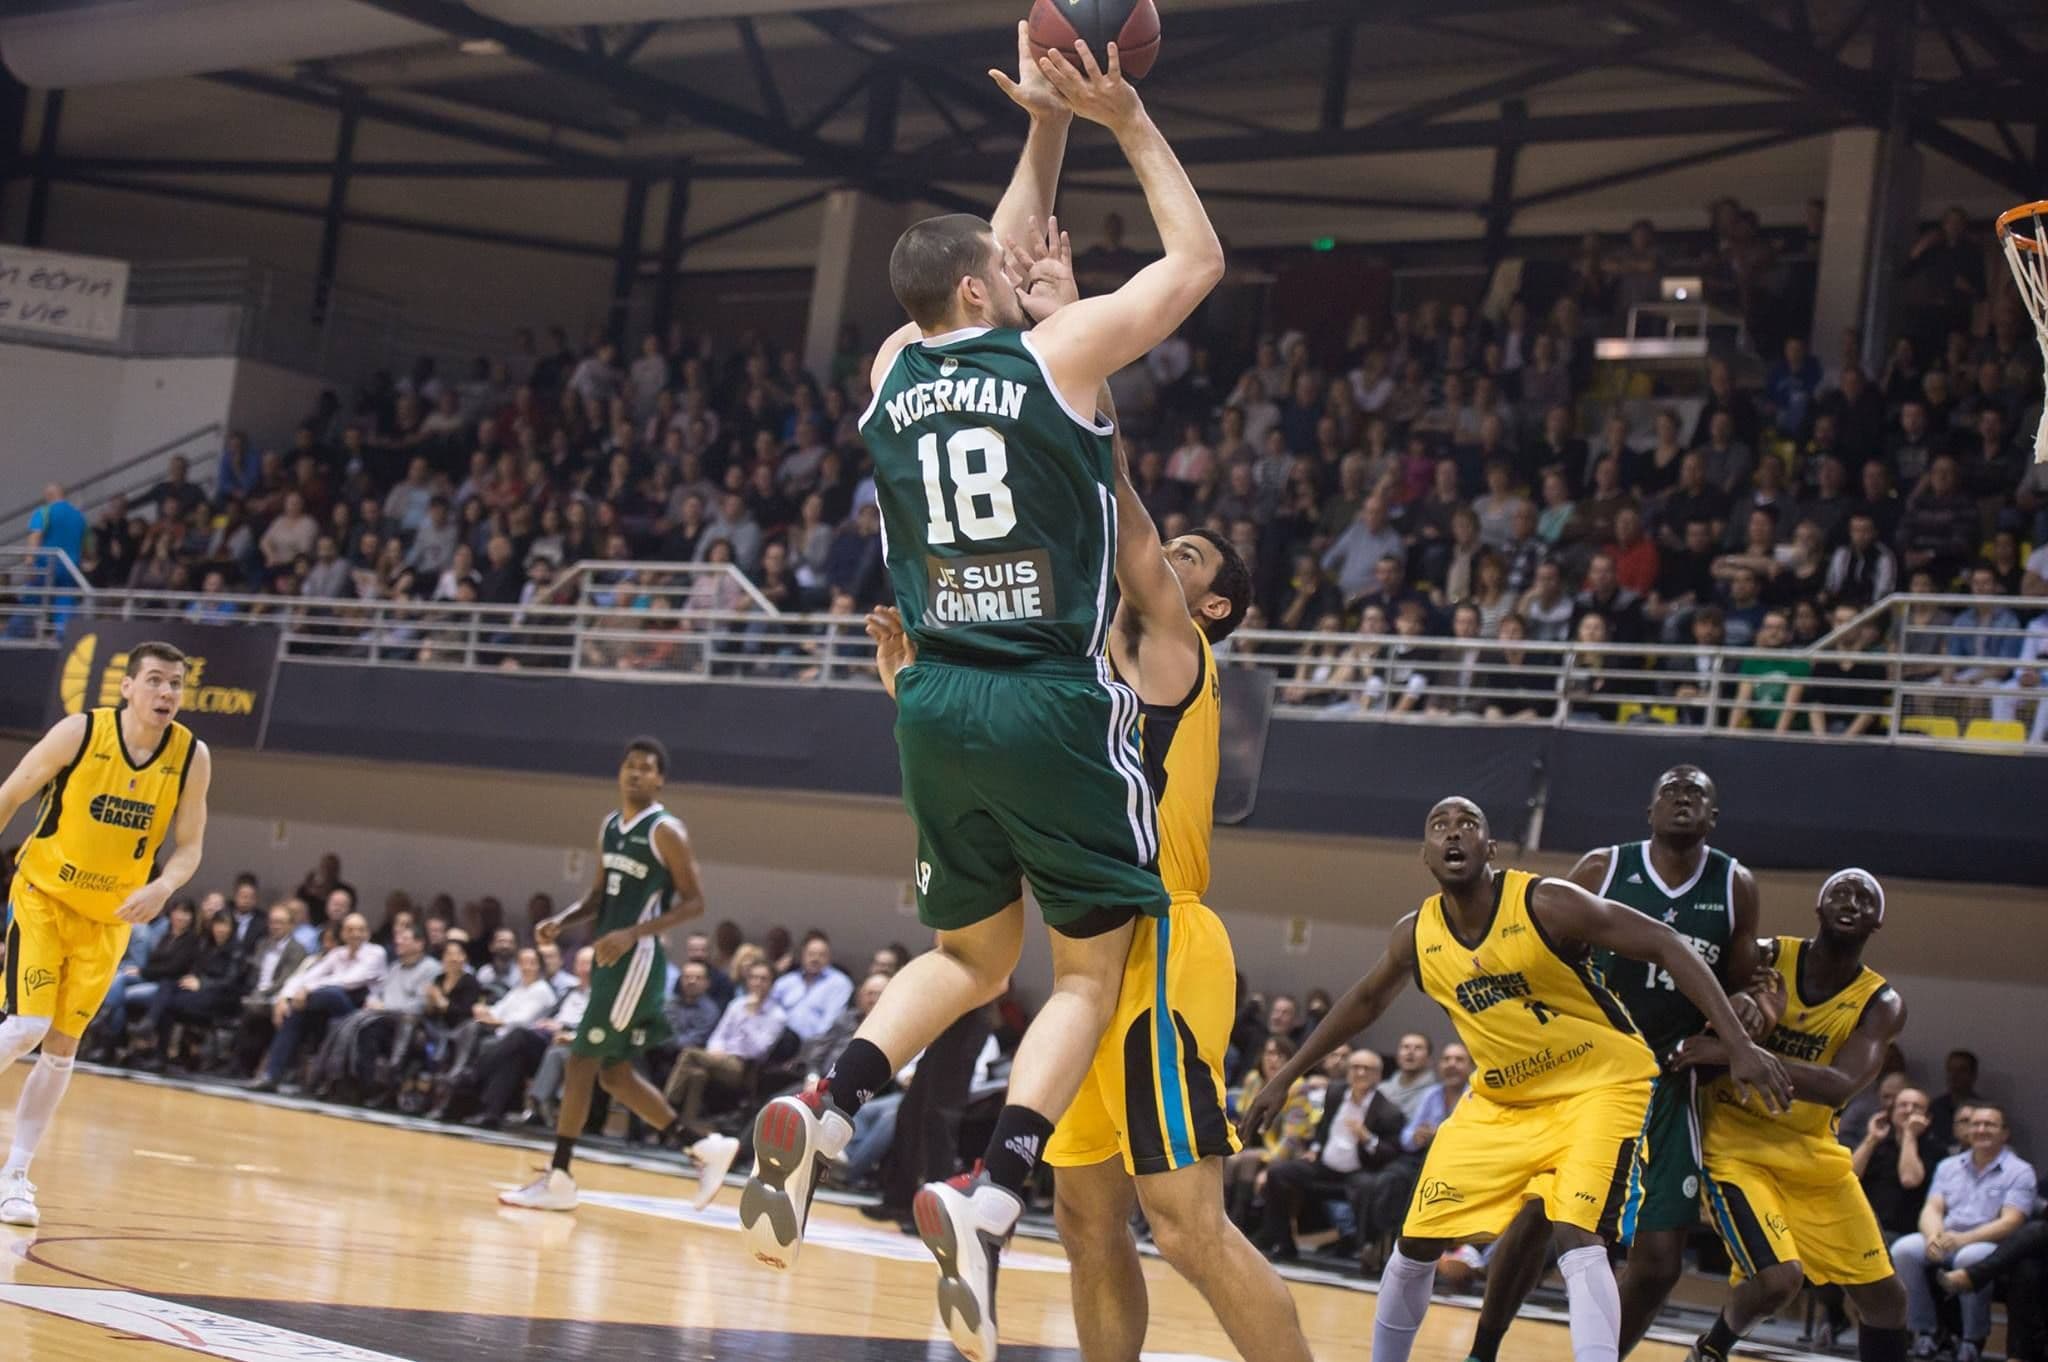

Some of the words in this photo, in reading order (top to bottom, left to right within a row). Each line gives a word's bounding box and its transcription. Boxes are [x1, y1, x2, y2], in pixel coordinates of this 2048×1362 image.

[885, 377, 1027, 434] MOERMAN
[917, 426, 1017, 545] 18
[936, 566, 960, 588] JE
[963, 560, 1038, 588] SUIS
[935, 586, 1043, 623] CHARLIE
[133, 836, 149, 860] 8
[1504, 1047, 1553, 1079] EIFFAGE
[1508, 1039, 1594, 1087] CONSTRUCTION
